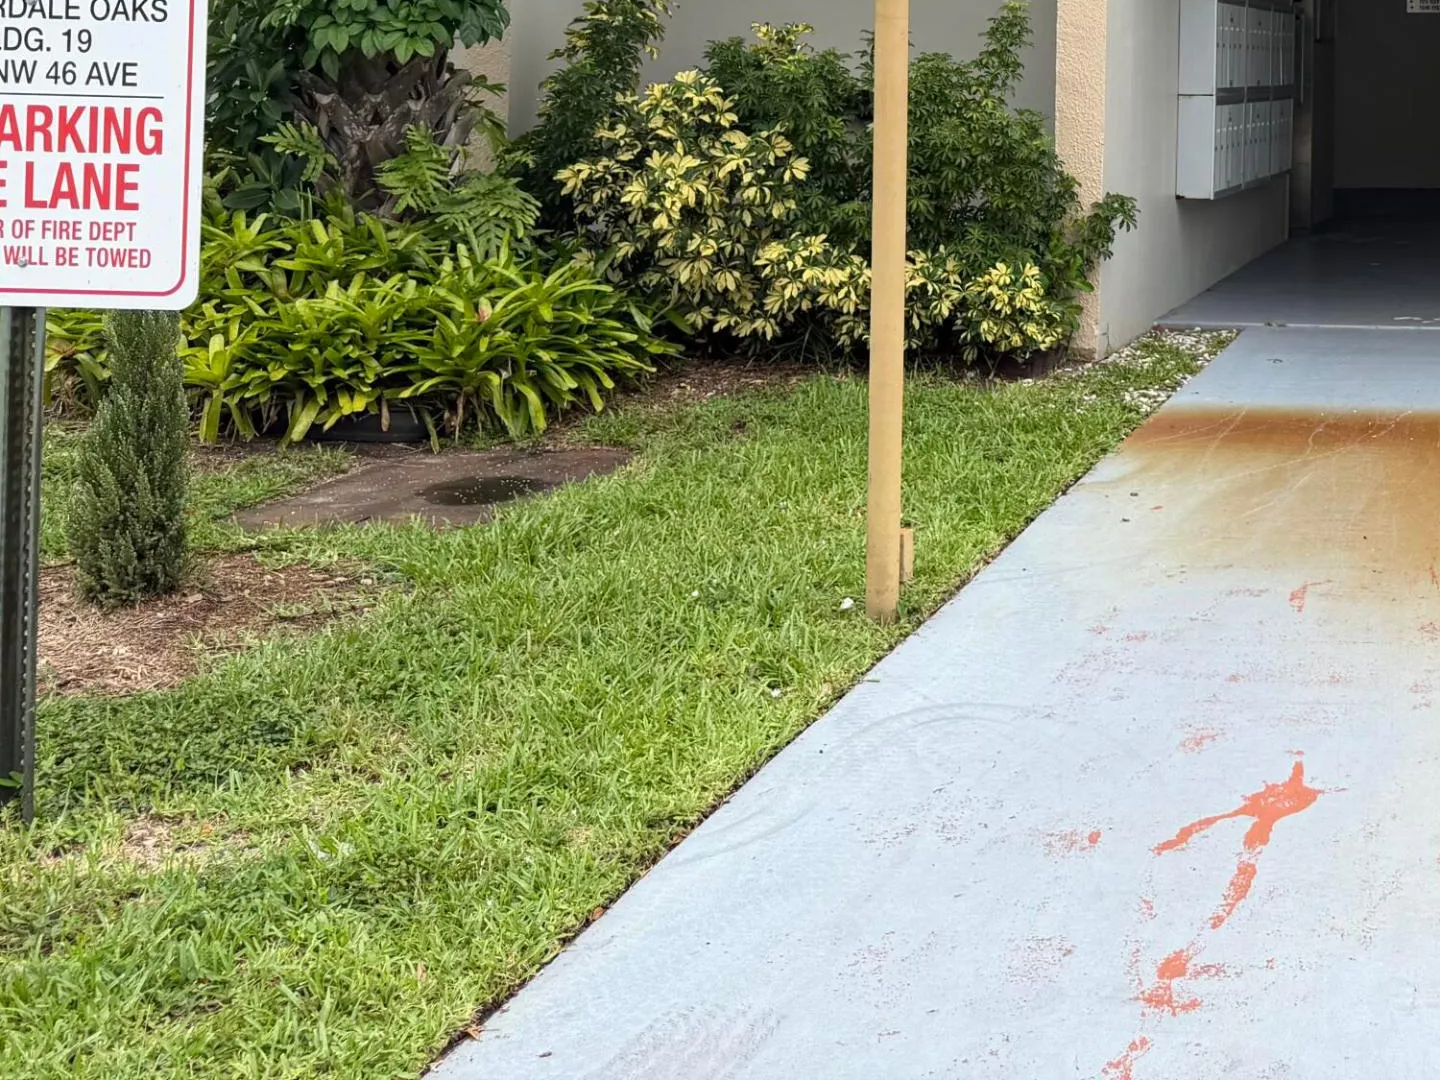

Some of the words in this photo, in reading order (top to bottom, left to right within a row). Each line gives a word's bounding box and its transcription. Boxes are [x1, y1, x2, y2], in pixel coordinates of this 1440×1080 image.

[0, 26, 51, 52] DG.
[62, 28, 92, 53] 19
[45, 60, 77, 85] 46
[85, 61, 138, 87] AVE
[24, 160, 140, 211] LANE
[11, 219, 35, 239] OF
[41, 220, 82, 241] FIRE
[89, 221, 137, 242] DEPT
[3, 245, 48, 266] WILL
[55, 246, 79, 266] BE
[85, 247, 151, 269] TOWED
